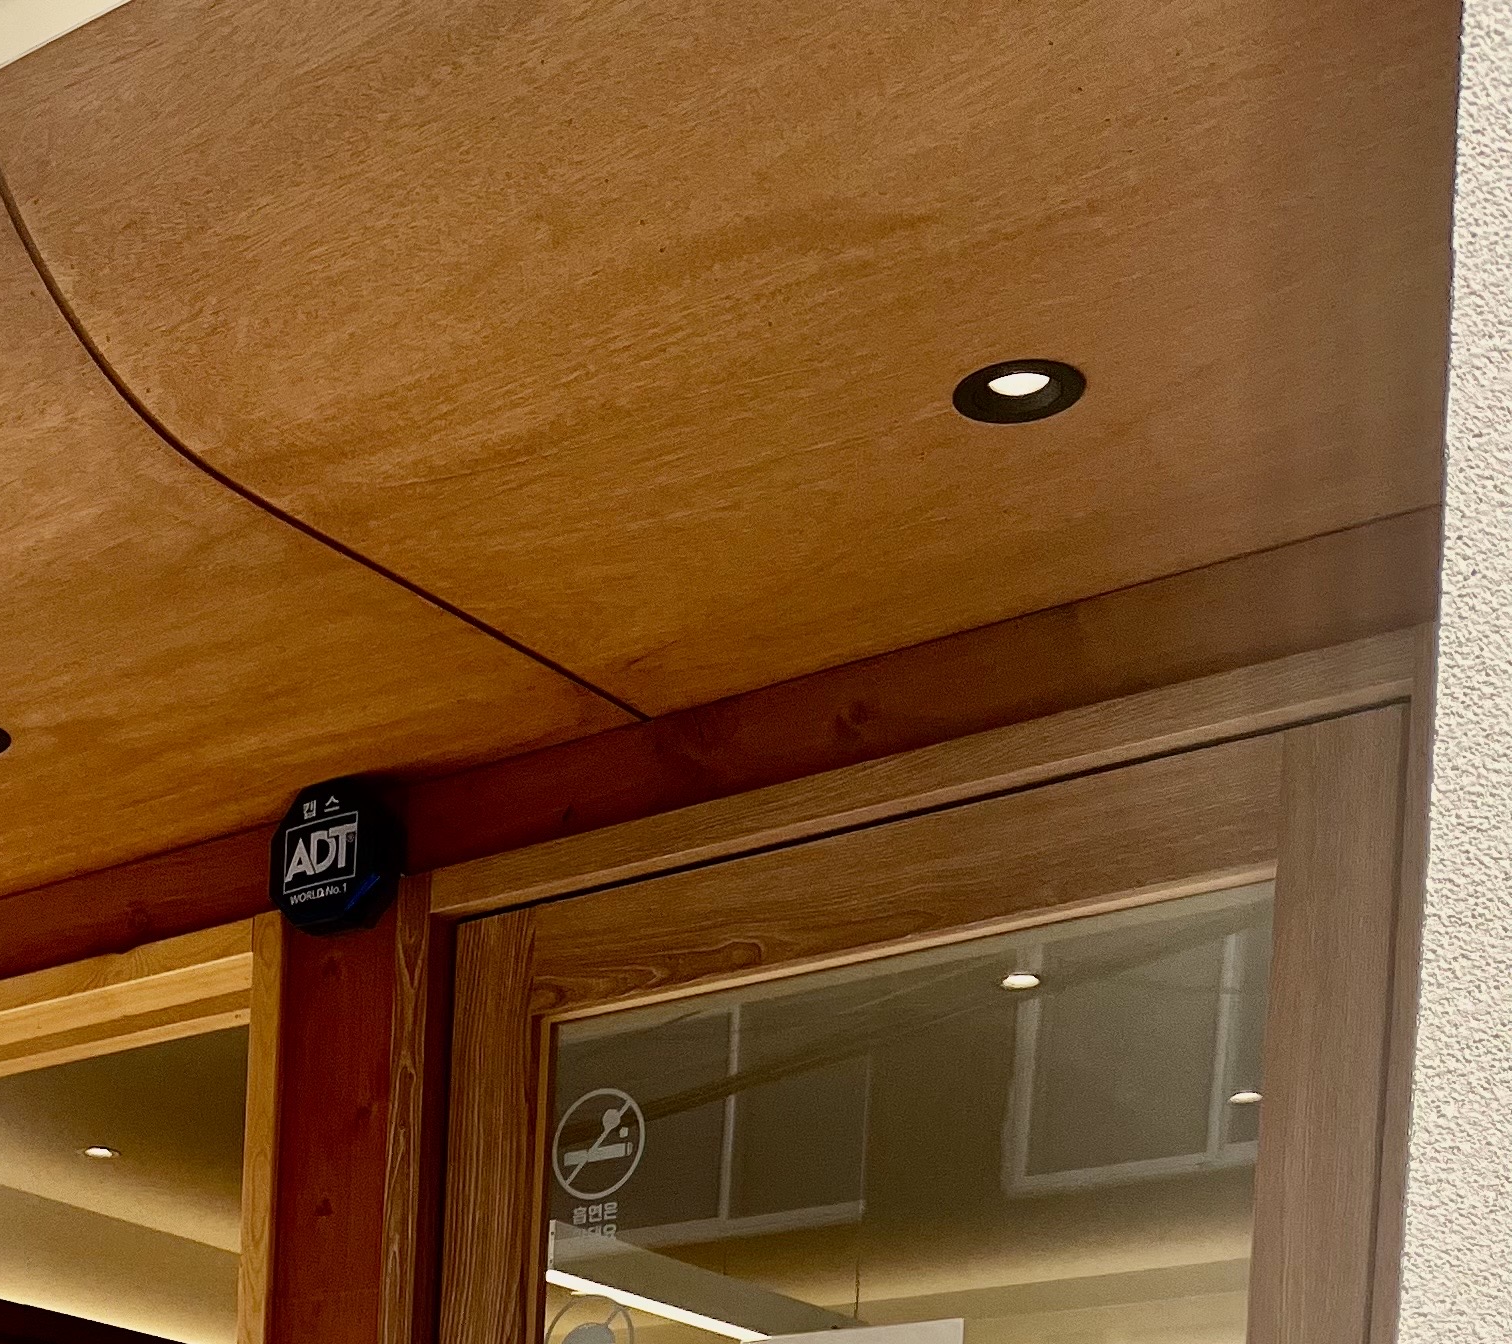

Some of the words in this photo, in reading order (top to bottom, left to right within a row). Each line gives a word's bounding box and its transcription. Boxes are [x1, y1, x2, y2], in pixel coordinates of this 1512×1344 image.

[303, 796, 340, 820] 캡스
[284, 823, 357, 883] ADT
[290, 888, 324, 905] WORLD
[573, 1202, 617, 1225] 흡연은
